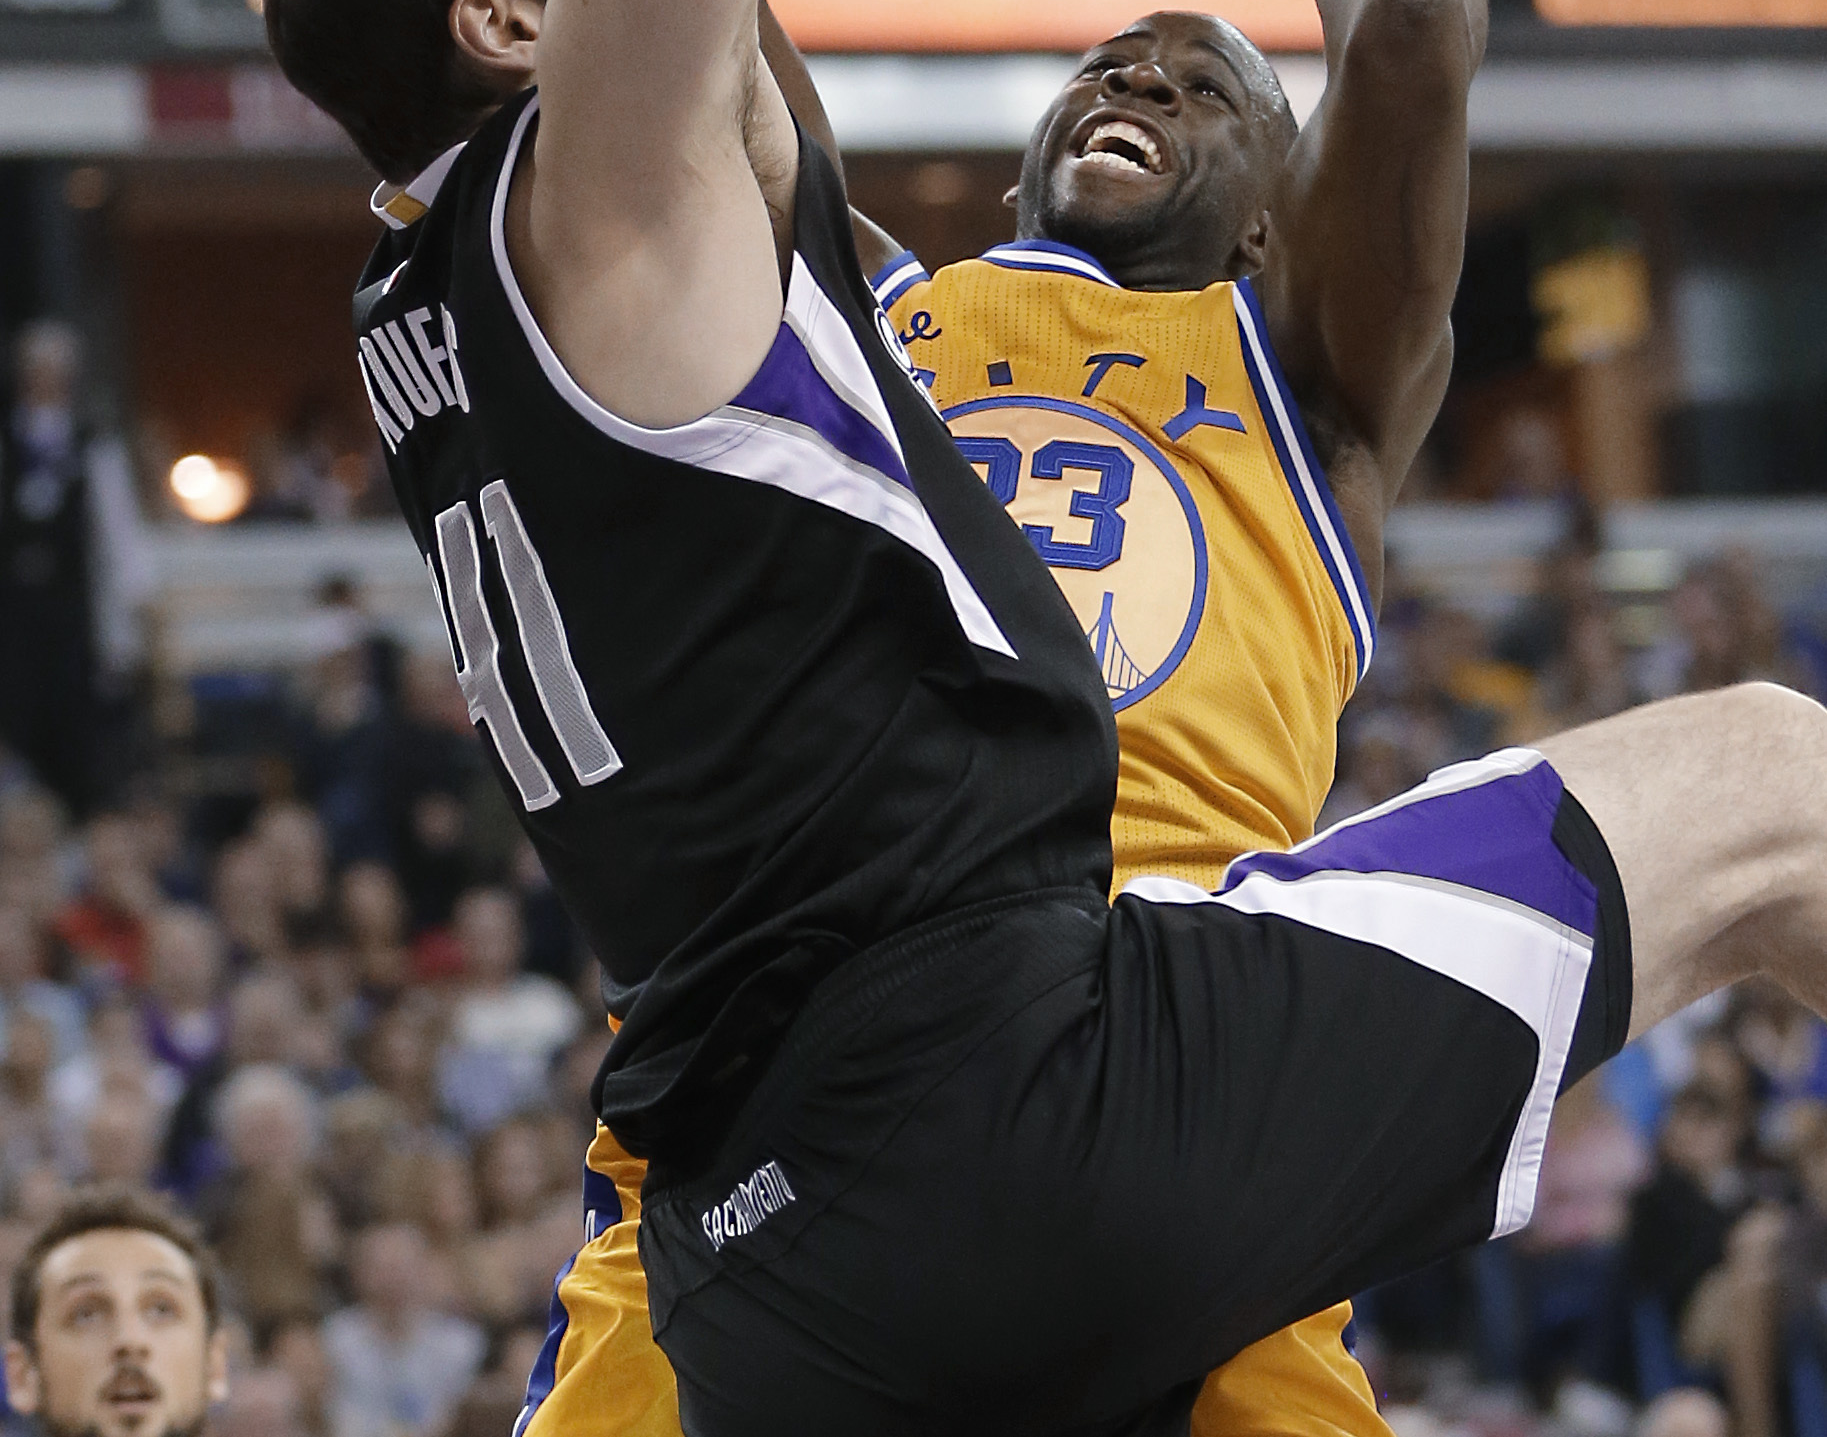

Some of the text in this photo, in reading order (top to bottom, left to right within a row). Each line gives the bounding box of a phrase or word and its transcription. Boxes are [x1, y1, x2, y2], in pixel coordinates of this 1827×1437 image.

[912, 352, 1247, 443] ITY
[426, 478, 624, 813] 41
[702, 1160, 796, 1253] SACRAMENTO
